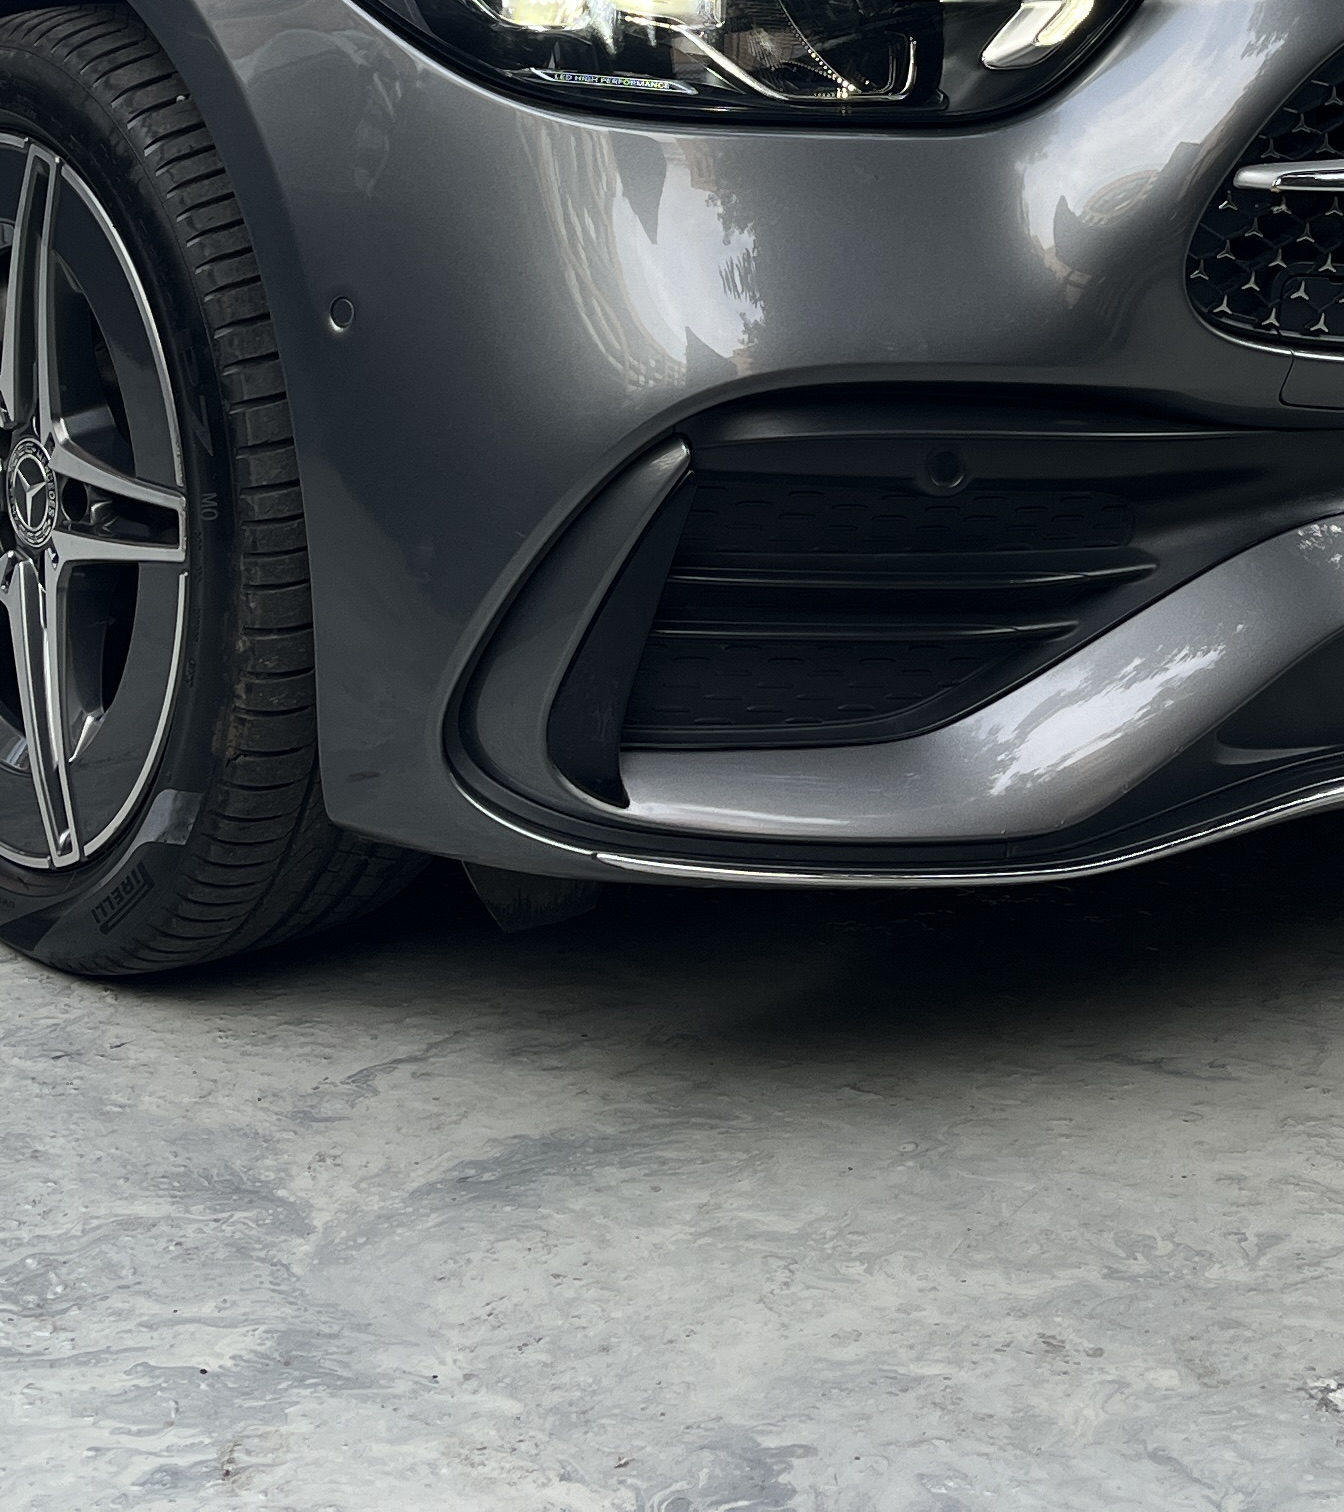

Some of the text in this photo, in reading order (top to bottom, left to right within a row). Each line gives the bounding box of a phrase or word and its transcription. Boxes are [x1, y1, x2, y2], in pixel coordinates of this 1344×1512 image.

[555, 72, 670, 89] LED HIGH PERFORMANCE
[90, 860, 155, 935] PIRELLI
